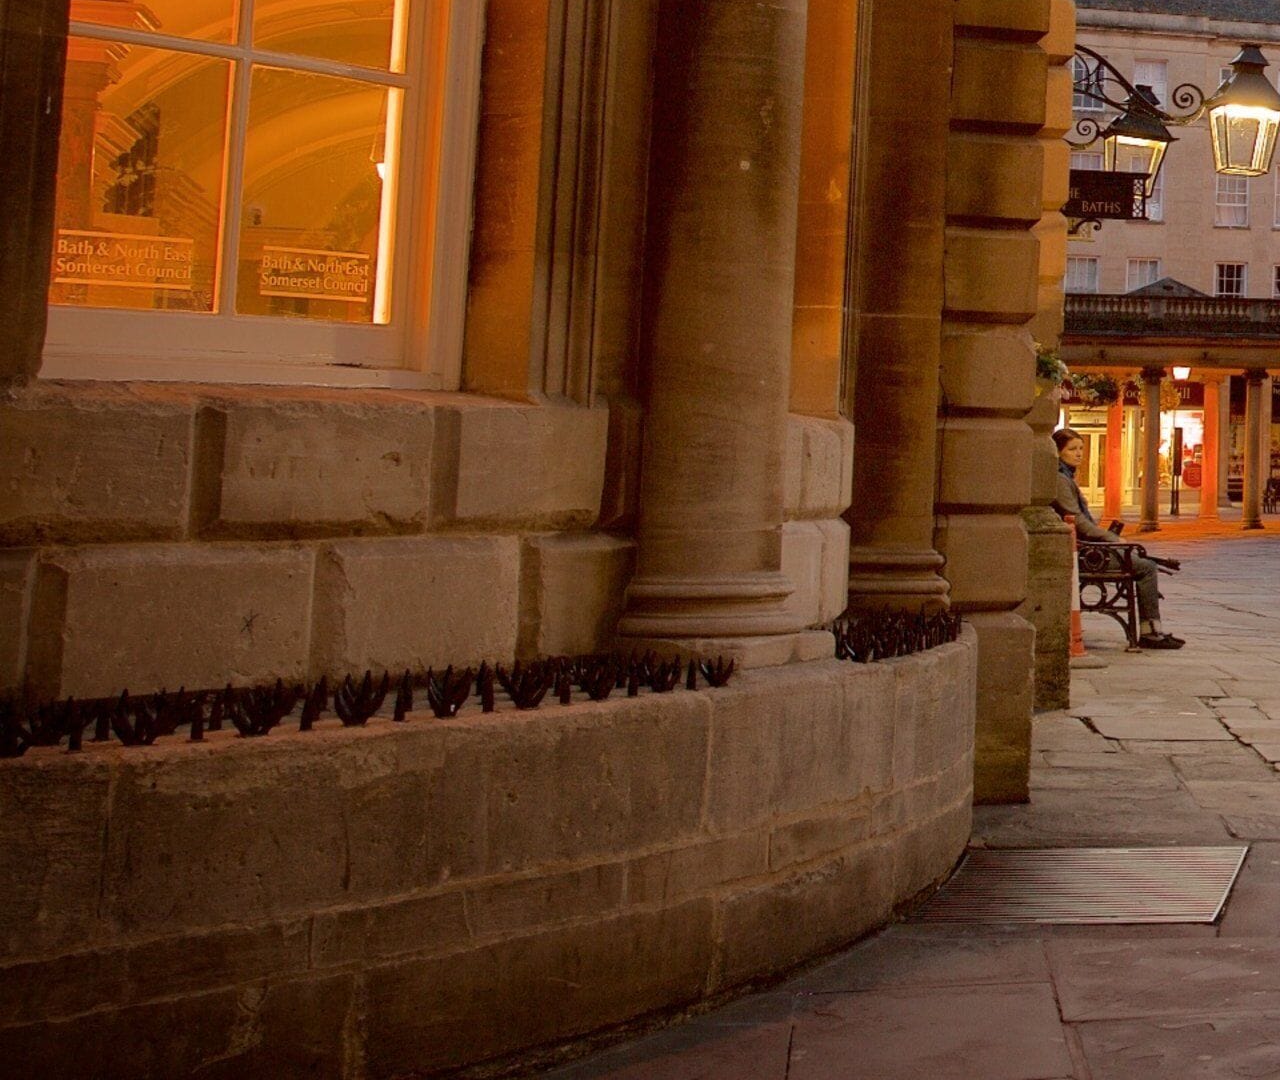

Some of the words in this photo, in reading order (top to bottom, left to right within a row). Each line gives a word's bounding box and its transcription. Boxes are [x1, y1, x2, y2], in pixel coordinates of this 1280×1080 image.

[1081, 200, 1121, 214] BATHS
[57, 239, 94, 255] Bath
[97, 242, 110, 256] &
[114, 244, 159, 260] North
[164, 246, 192, 262] East
[56, 257, 131, 276] Somerset
[136, 263, 192, 279] Council
[262, 255, 292, 270] Bath
[293, 257, 304, 270] &
[307, 259, 343, 273] North
[346, 261, 369, 276] East
[261, 272, 320, 289] Somerset
[323, 276, 368, 293] Council
